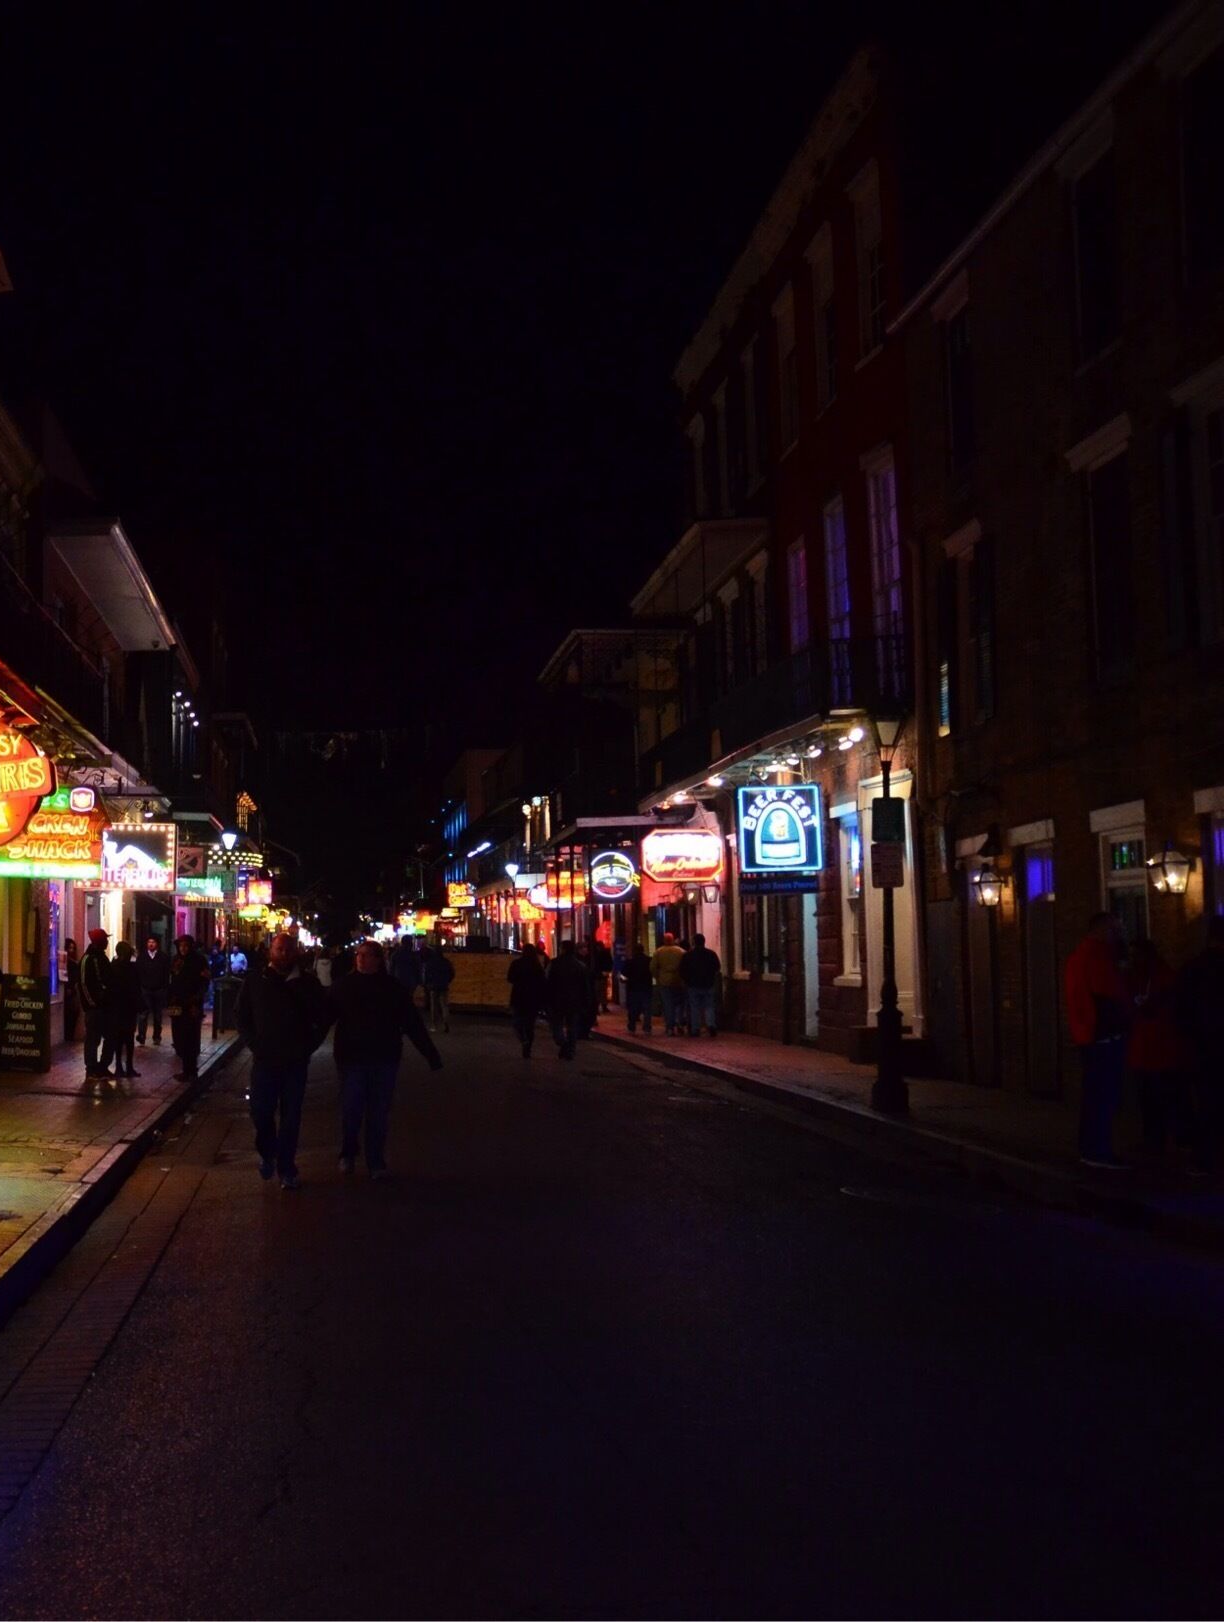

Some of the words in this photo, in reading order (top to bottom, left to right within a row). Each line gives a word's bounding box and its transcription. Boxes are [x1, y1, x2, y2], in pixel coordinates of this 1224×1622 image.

[743, 789, 778, 831] BEER
[782, 790, 817, 827] FEST
[28, 814, 90, 835] CKEN
[7, 840, 91, 860] SHACK
